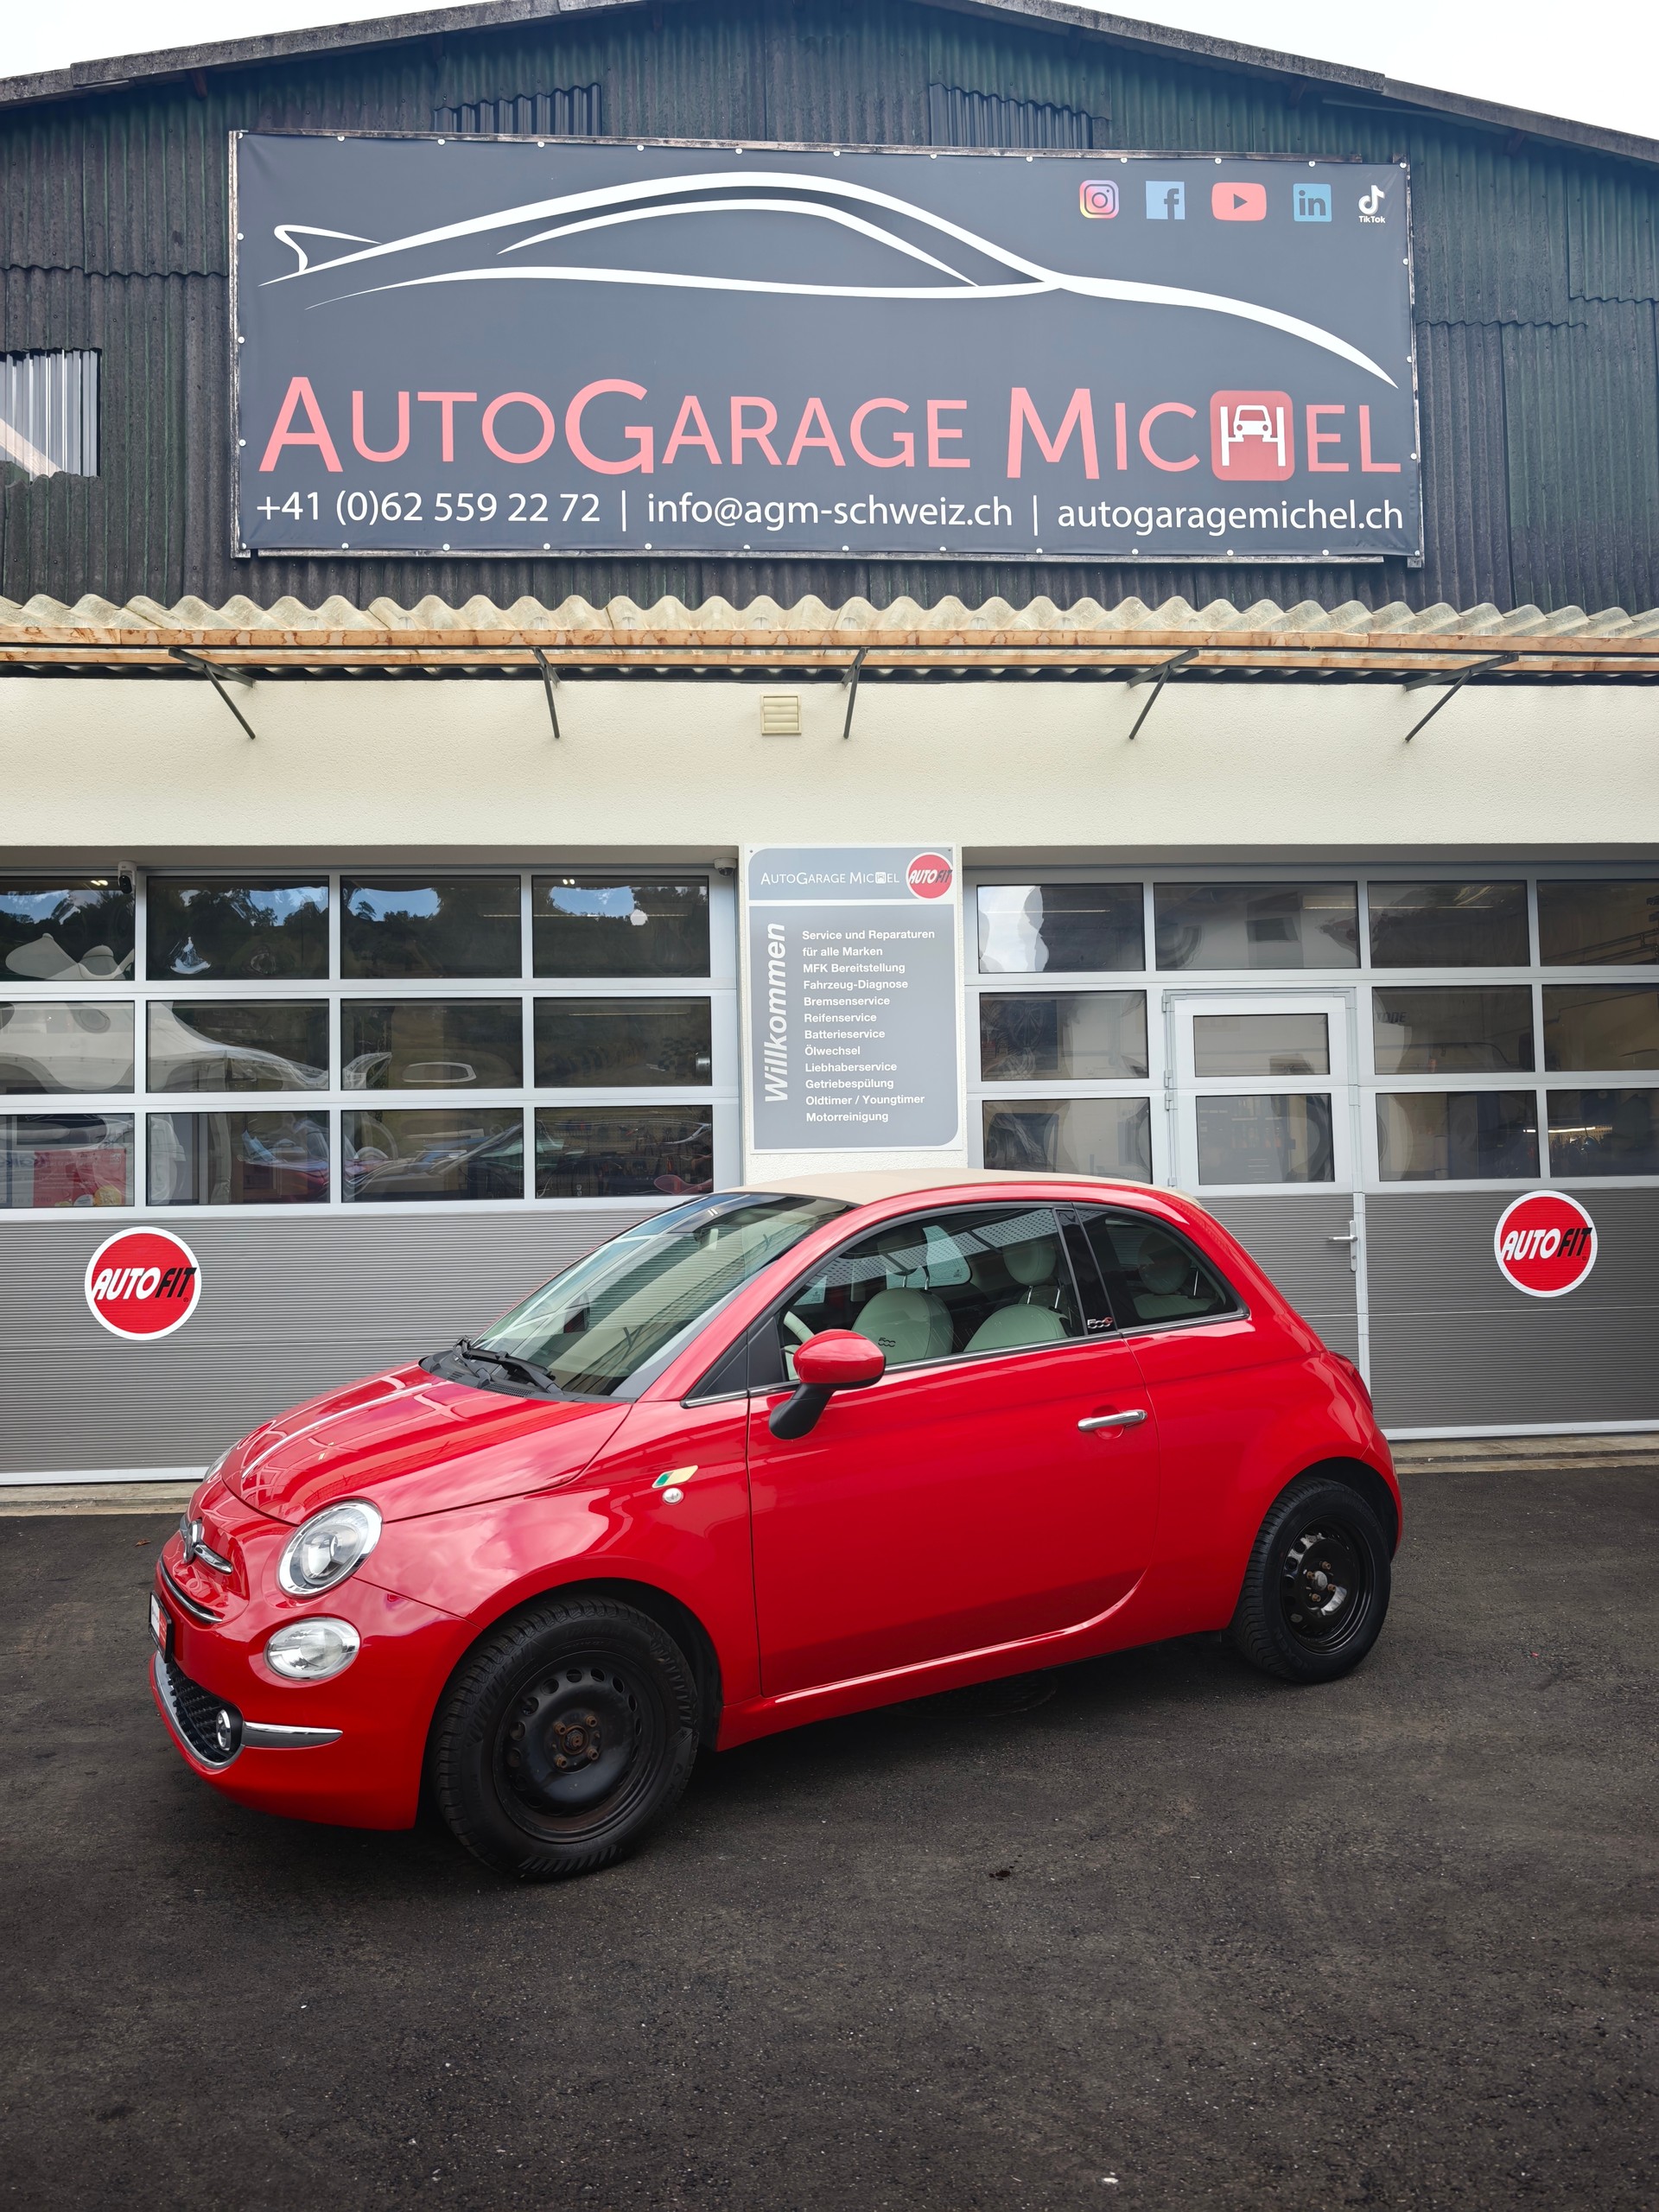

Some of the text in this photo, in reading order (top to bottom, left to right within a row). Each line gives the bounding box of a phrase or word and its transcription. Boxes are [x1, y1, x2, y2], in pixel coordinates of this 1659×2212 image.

[1358, 215, 1386, 224] TikTok
[257, 492, 319, 520] +41
[336, 490, 423, 524] (0)62
[434, 493, 498, 522] 559
[507, 493, 549, 522] 22
[560, 493, 601, 522] 72
[648, 493, 1013, 531] info@agm-schweiz.ch
[1058, 499, 1403, 537] autogaragemichel.ch
[802, 930, 936, 942] Service und Reparaturen
[802, 946, 883, 957] für alle Marken
[803, 963, 906, 975] MFK Bereitstellung
[803, 979, 909, 991] Fahrzeug-Diagnose
[804, 996, 891, 1007] Bremsenservice
[764, 922, 789, 1103] Willkommen
[804, 1013, 878, 1023] Reifenservice
[804, 1029, 886, 1039] Batterieservice
[804, 1045, 861, 1056] Ölwechsel
[804, 1062, 898, 1072] Liebhaberservice
[804, 1078, 894, 1090] Getriebespülung
[805, 1096, 853, 1106] Oldtimer
[861, 1095, 925, 1107] Youngtimer
[806, 1111, 889, 1123] Motorreinigung
